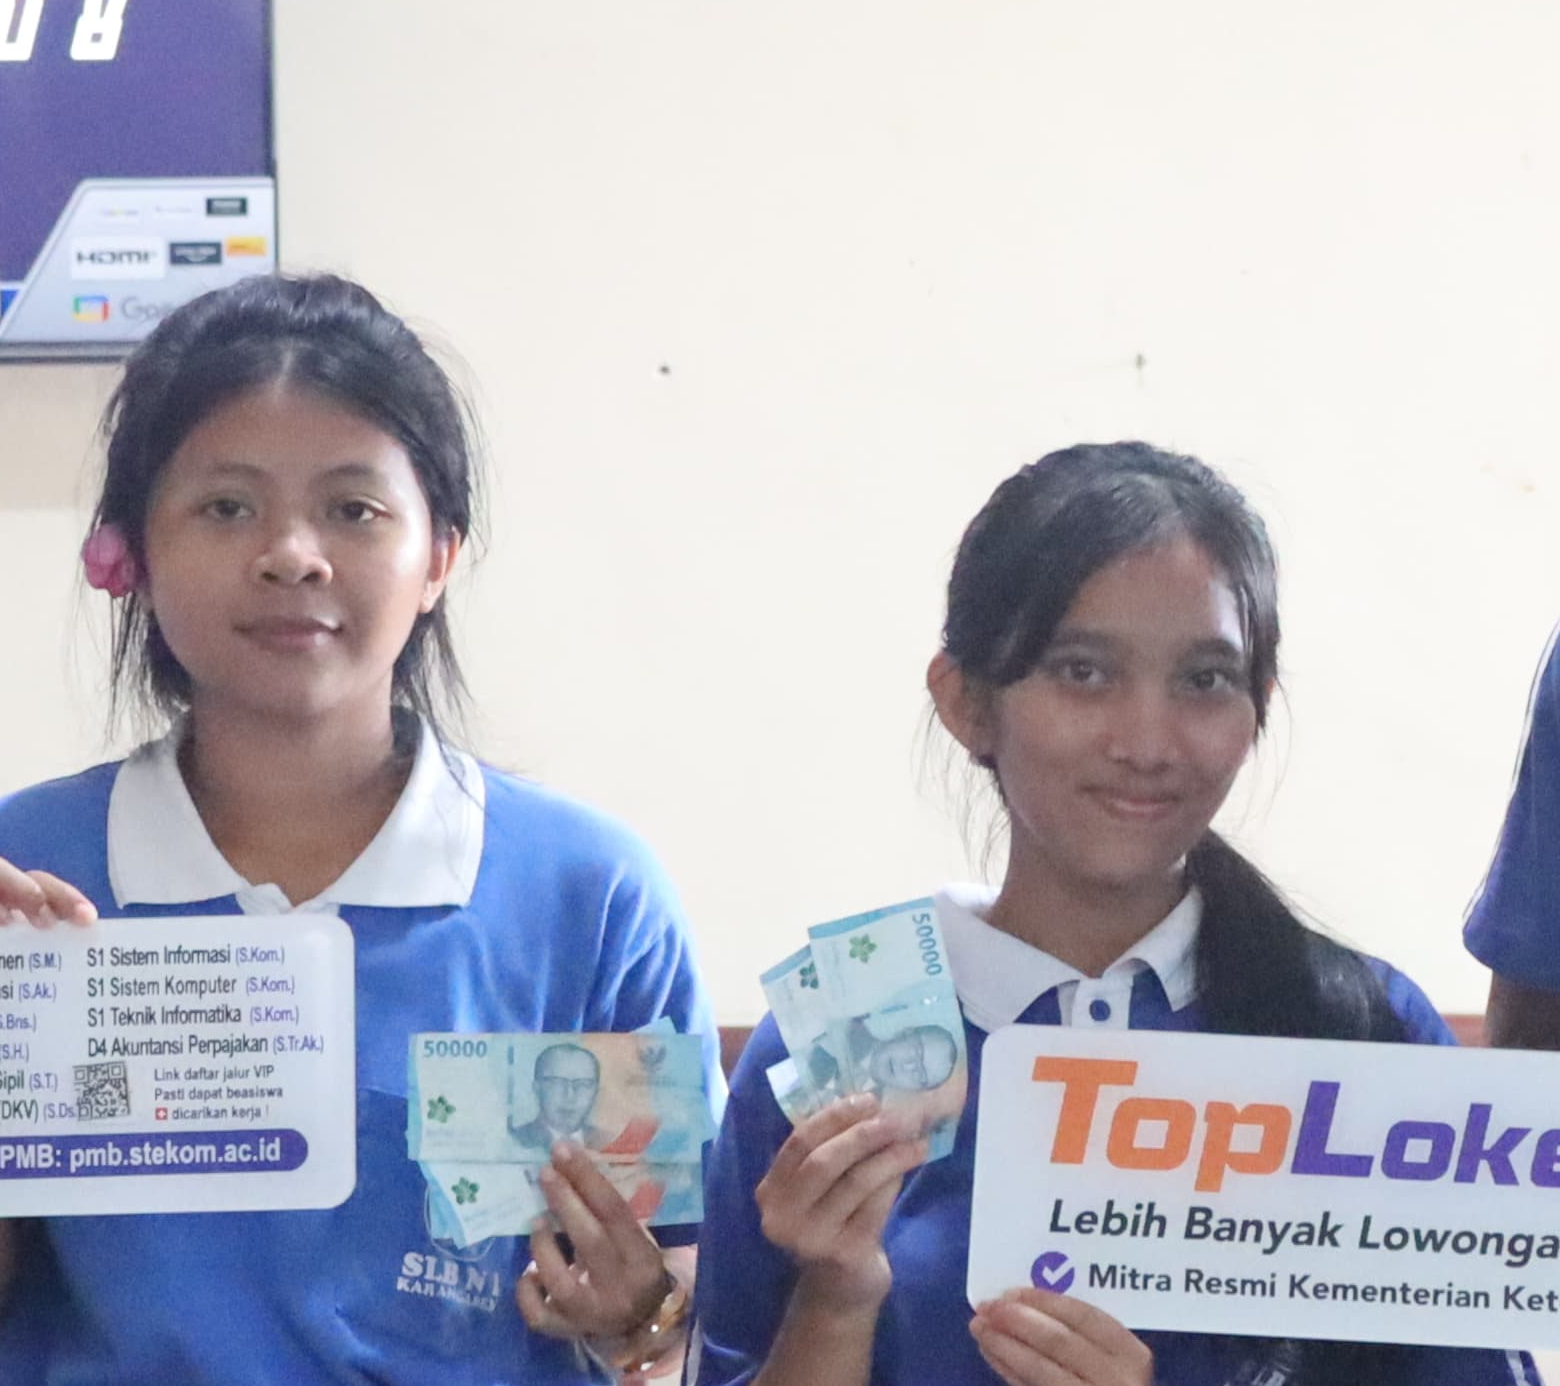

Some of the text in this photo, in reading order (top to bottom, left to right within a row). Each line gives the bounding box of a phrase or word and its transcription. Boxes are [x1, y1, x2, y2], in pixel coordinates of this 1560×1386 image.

[87, 947, 105, 966] S1
[110, 947, 159, 966] Sistem
[164, 945, 231, 965] Informasi
[912, 913, 943, 976] 50000
[28, 952, 62, 970] (S.M.)
[87, 978, 105, 997] S1
[110, 977, 160, 997] Sistem
[165, 976, 237, 999] Komputer
[88, 1008, 106, 1027] S1
[110, 1007, 156, 1026] Teknik
[161, 1007, 241, 1025] Informatika
[88, 1039, 107, 1057] D4
[111, 1037, 184, 1057] Akuntansi
[188, 1035, 269, 1059] Perpajakan
[423, 1039, 487, 1058] 50000
[154, 1065, 274, 1081] Link daftar jalur VIP
[154, 1086, 283, 1103] Pasti dapat beasiswa
[172, 1106, 227, 1121] dicarikan
[231, 1107, 261, 1122] kerja
[0, 1145, 61, 1169] PMB:
[70, 1138, 281, 1173] pmb.stekom.ac.id
[1048, 1199, 1167, 1239] Lebih
[1184, 1205, 1344, 1255] Banyak
[401, 1251, 460, 1285] SLB
[1088, 1263, 1172, 1293] Mitra
[1184, 1269, 1276, 1299] Resmi
[1288, 1275, 1490, 1309] Kementerian
